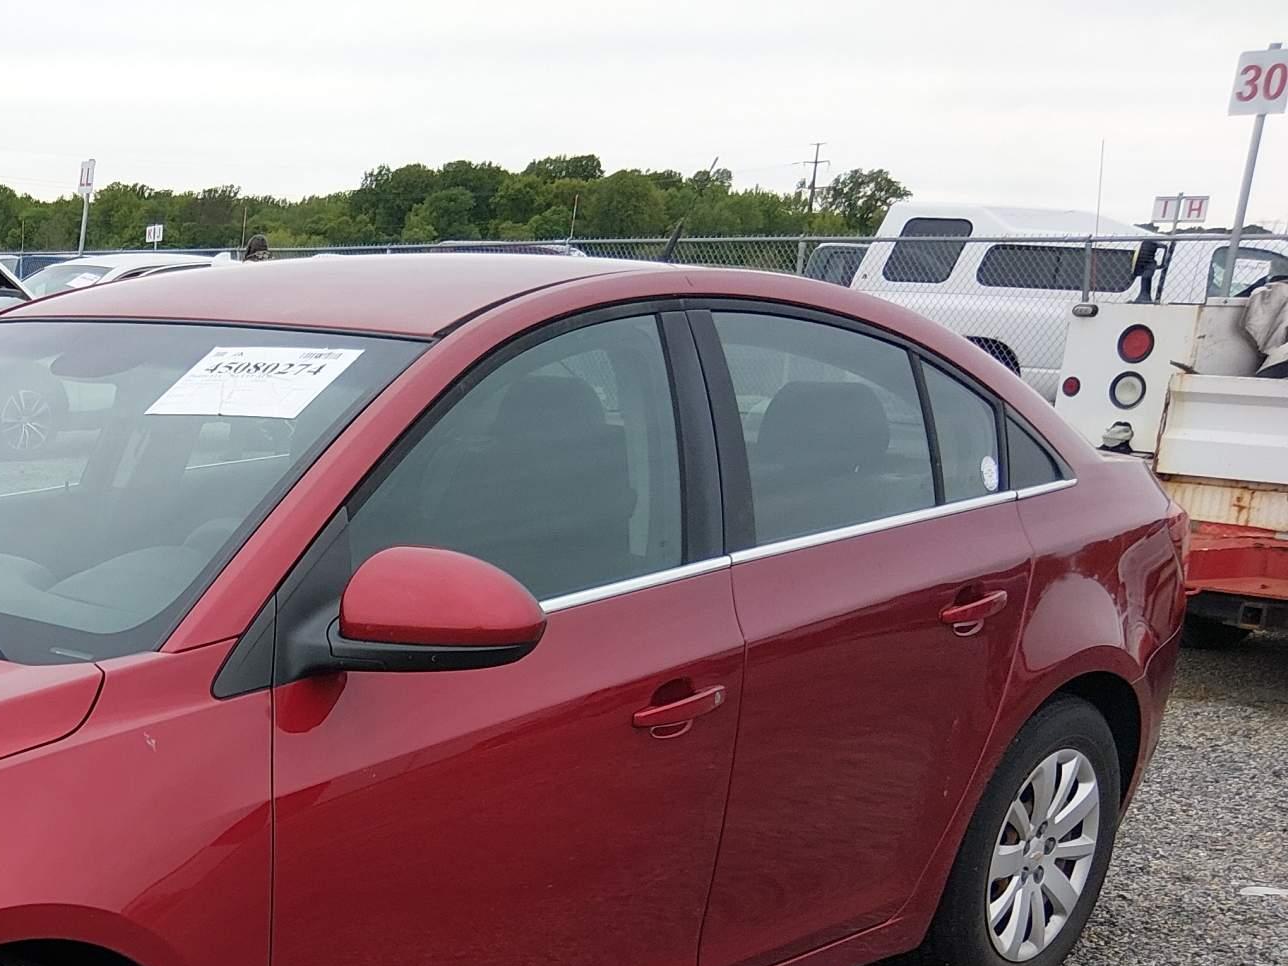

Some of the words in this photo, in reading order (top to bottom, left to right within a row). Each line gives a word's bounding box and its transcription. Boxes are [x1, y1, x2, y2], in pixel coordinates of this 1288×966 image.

[1236, 63, 1288, 102] 30
[1187, 200, 1203, 219] H
[204, 361, 328, 376] 45080274
